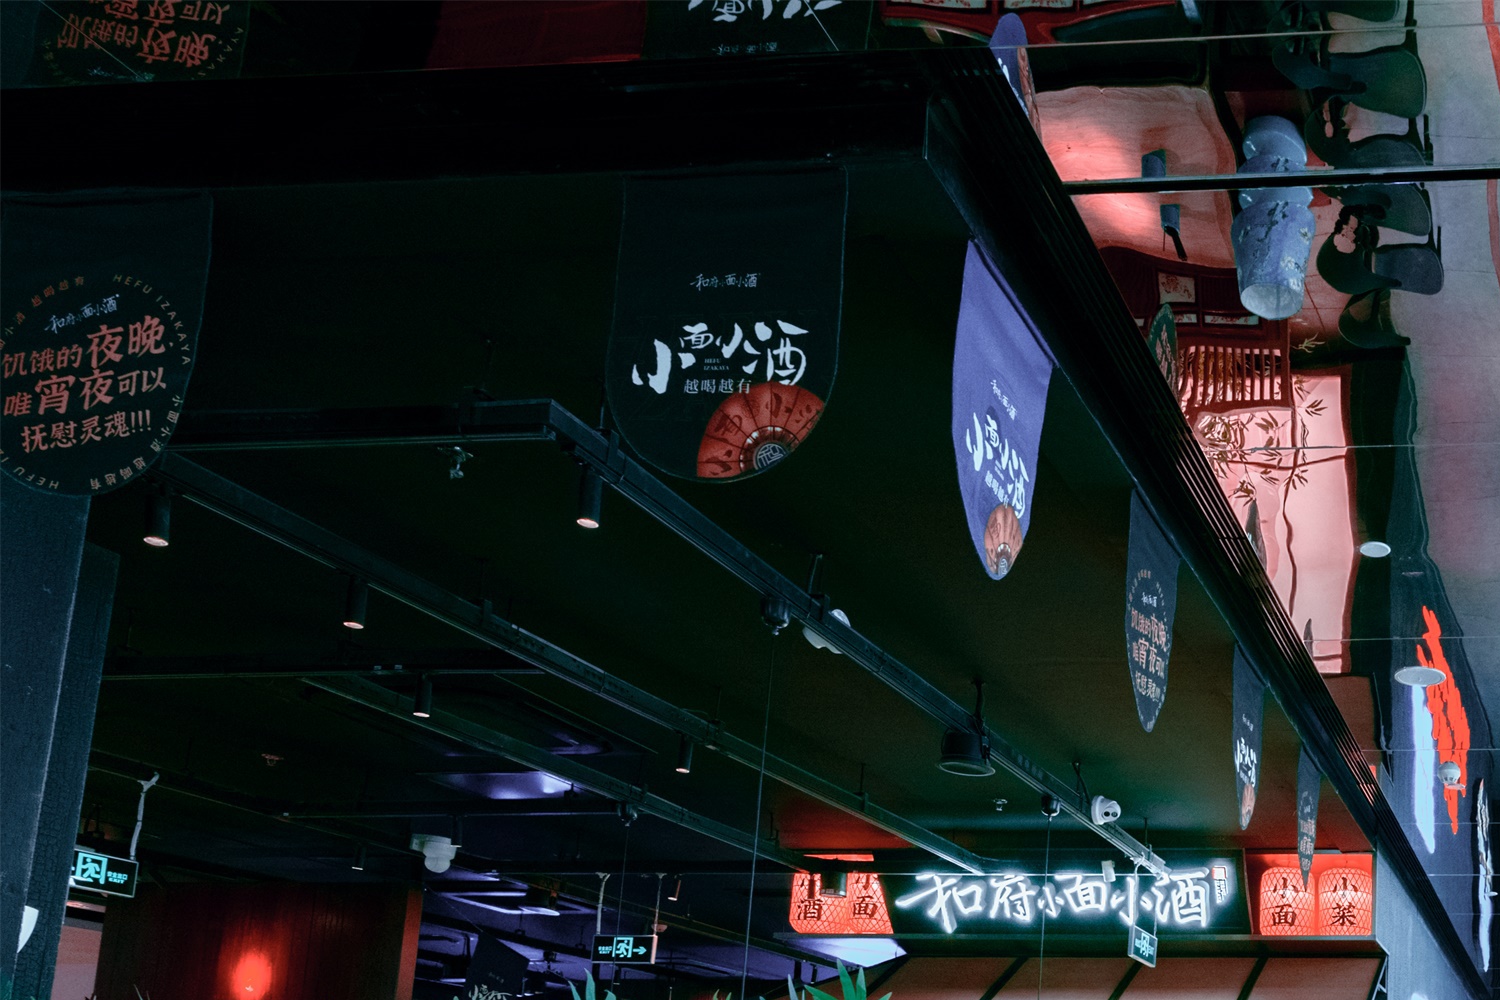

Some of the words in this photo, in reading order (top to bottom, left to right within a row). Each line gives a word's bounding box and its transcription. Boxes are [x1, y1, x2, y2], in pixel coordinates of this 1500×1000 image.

[111, 273, 153, 295] HEFU
[155, 294, 192, 367] IZAKAYA
[631, 319, 810, 395] 小面小酒
[3, 365, 168, 418] 唯宵夜可以
[683, 378, 752, 395] 越喝越有
[894, 867, 1211, 935] 和府小面小酒
[1271, 874, 1299, 928] 小面
[1331, 875, 1359, 928] 小菜
